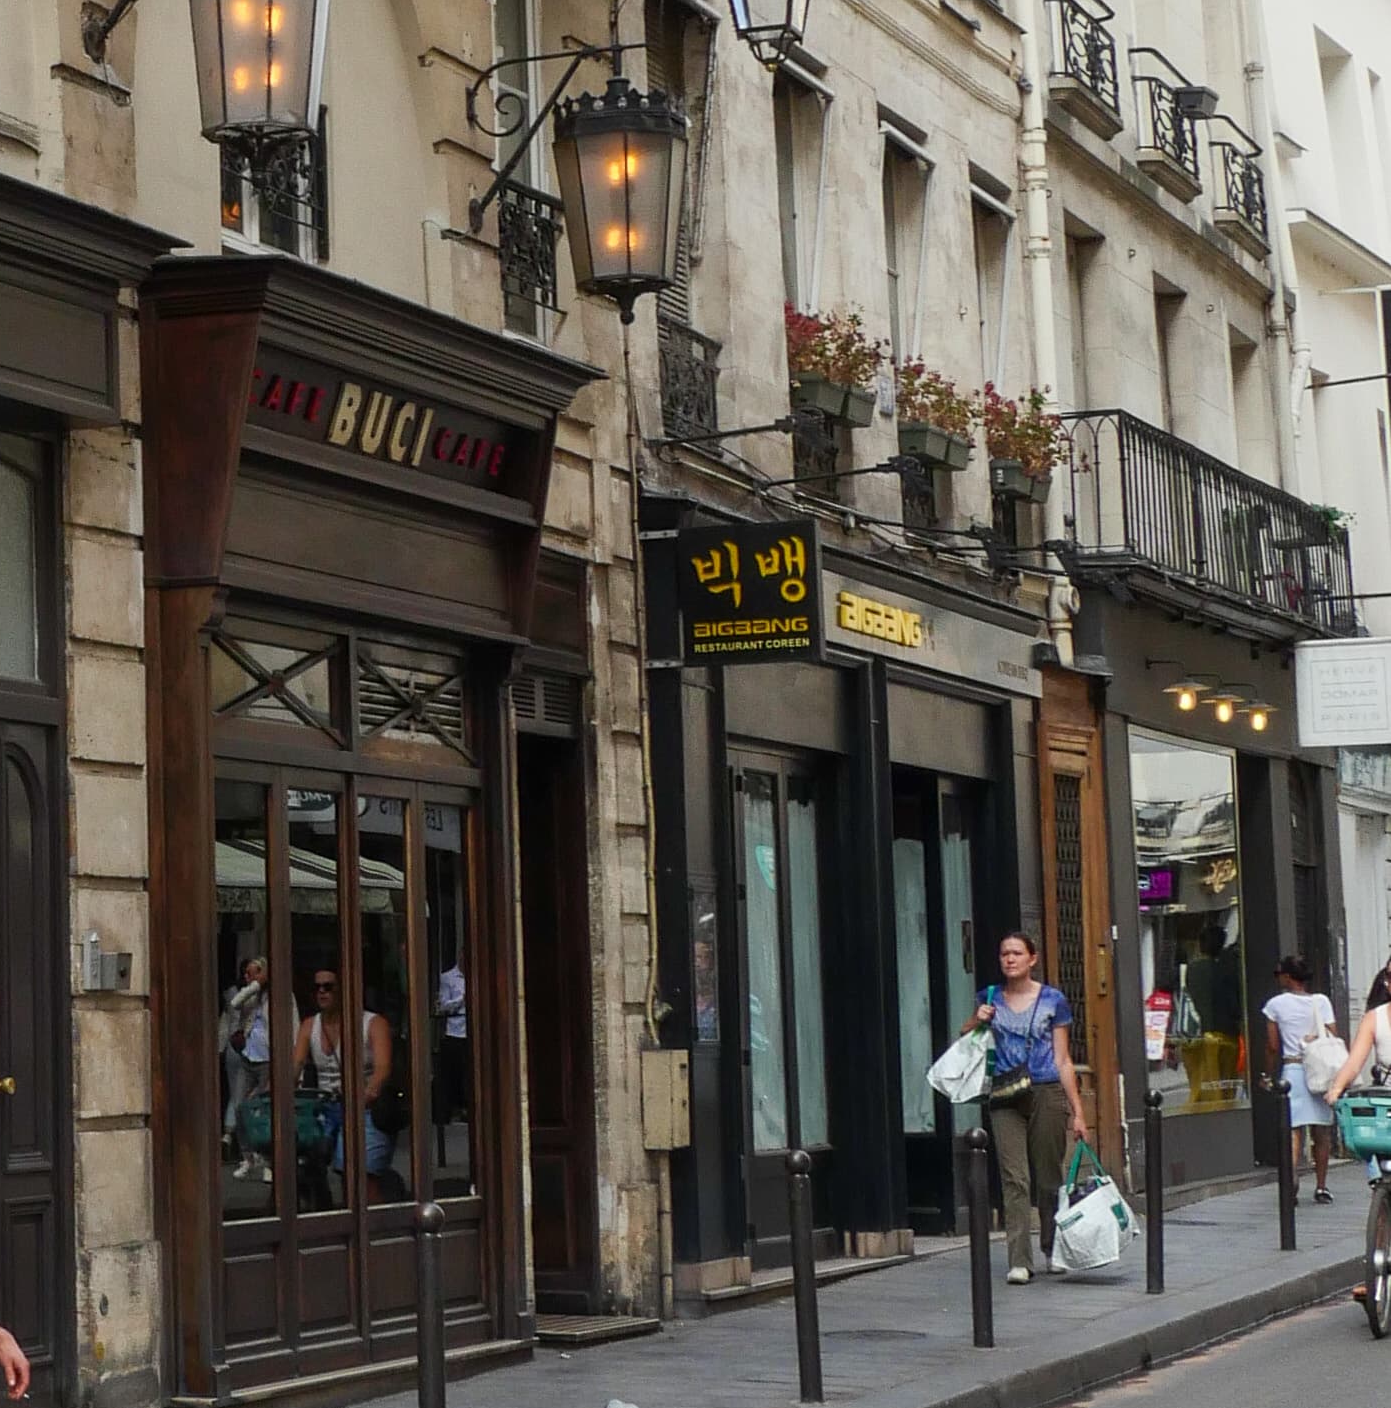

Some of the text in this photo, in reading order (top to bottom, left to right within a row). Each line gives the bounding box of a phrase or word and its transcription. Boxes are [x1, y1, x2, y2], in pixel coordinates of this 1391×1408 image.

[328, 381, 434, 468] BUCI
[436, 428, 505, 476] CAFE
[693, 617, 809, 638] BIGBANG
[838, 590, 922, 648] BIGBANG
[693, 637, 810, 653] RESTAURANT COREEN
